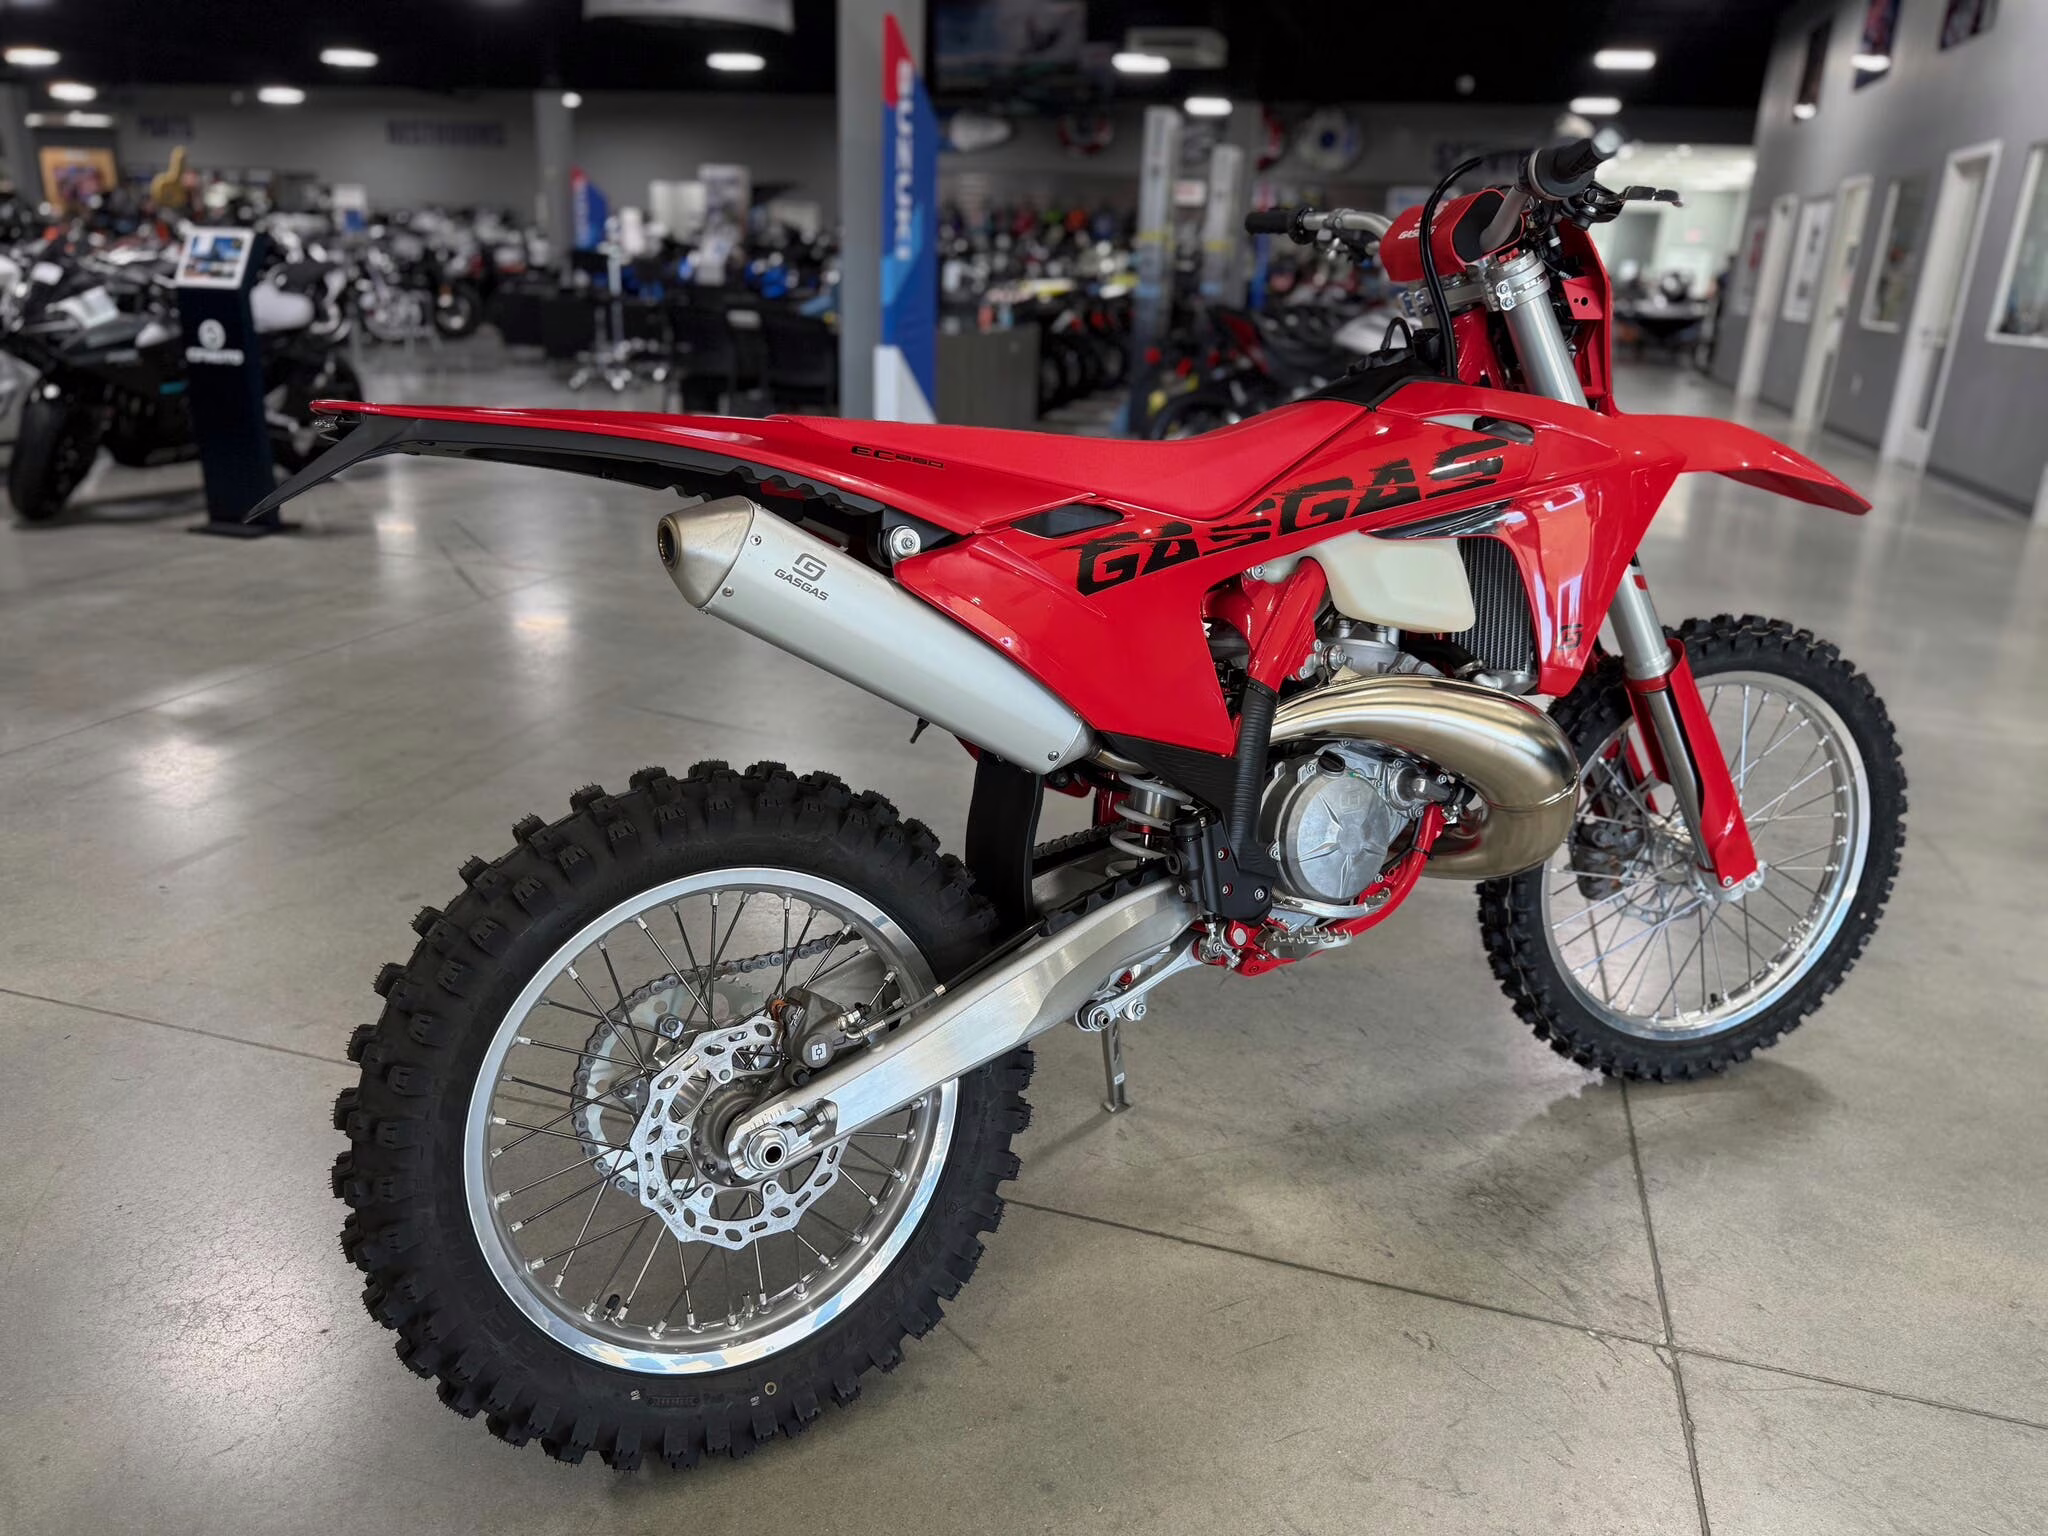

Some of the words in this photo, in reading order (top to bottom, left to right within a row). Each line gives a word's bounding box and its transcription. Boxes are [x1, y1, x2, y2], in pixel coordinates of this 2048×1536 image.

[895, 57, 914, 260] SUZUKI
[774, 568, 829, 601] GASGAS
[1060, 438, 1509, 596] GASGAS
